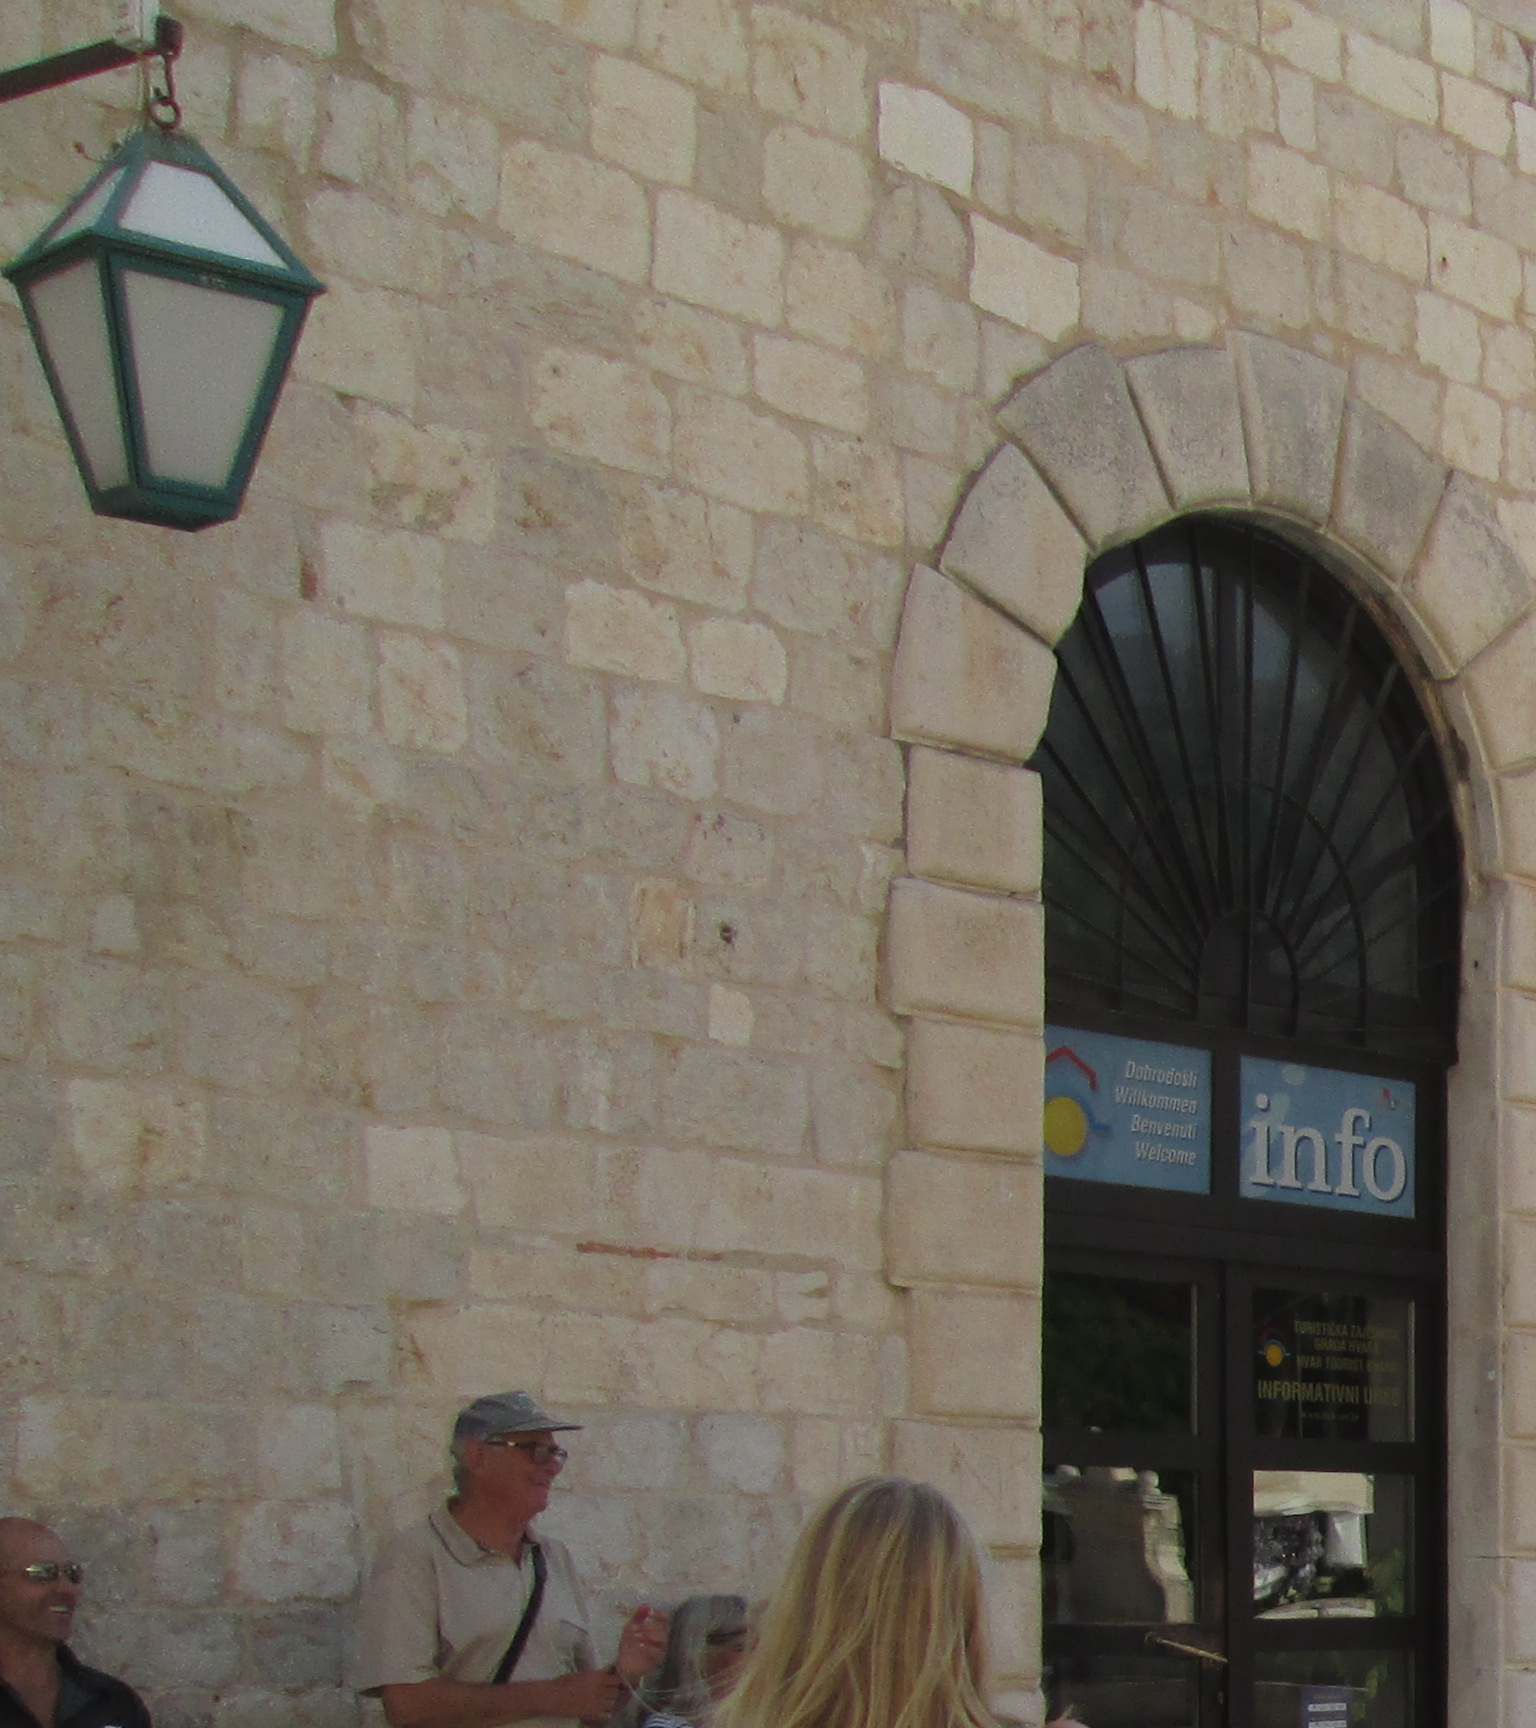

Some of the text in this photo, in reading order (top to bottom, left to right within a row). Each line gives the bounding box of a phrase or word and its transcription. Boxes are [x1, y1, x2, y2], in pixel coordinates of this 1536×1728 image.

[1114, 1085, 1198, 1114] Willkommen
[1131, 1114, 1198, 1140] Benvenuti
[1135, 1140, 1197, 1166] Welcome
[1249, 1093, 1408, 1203] info
[1258, 1381, 1360, 1405] INFORMATIVNI
